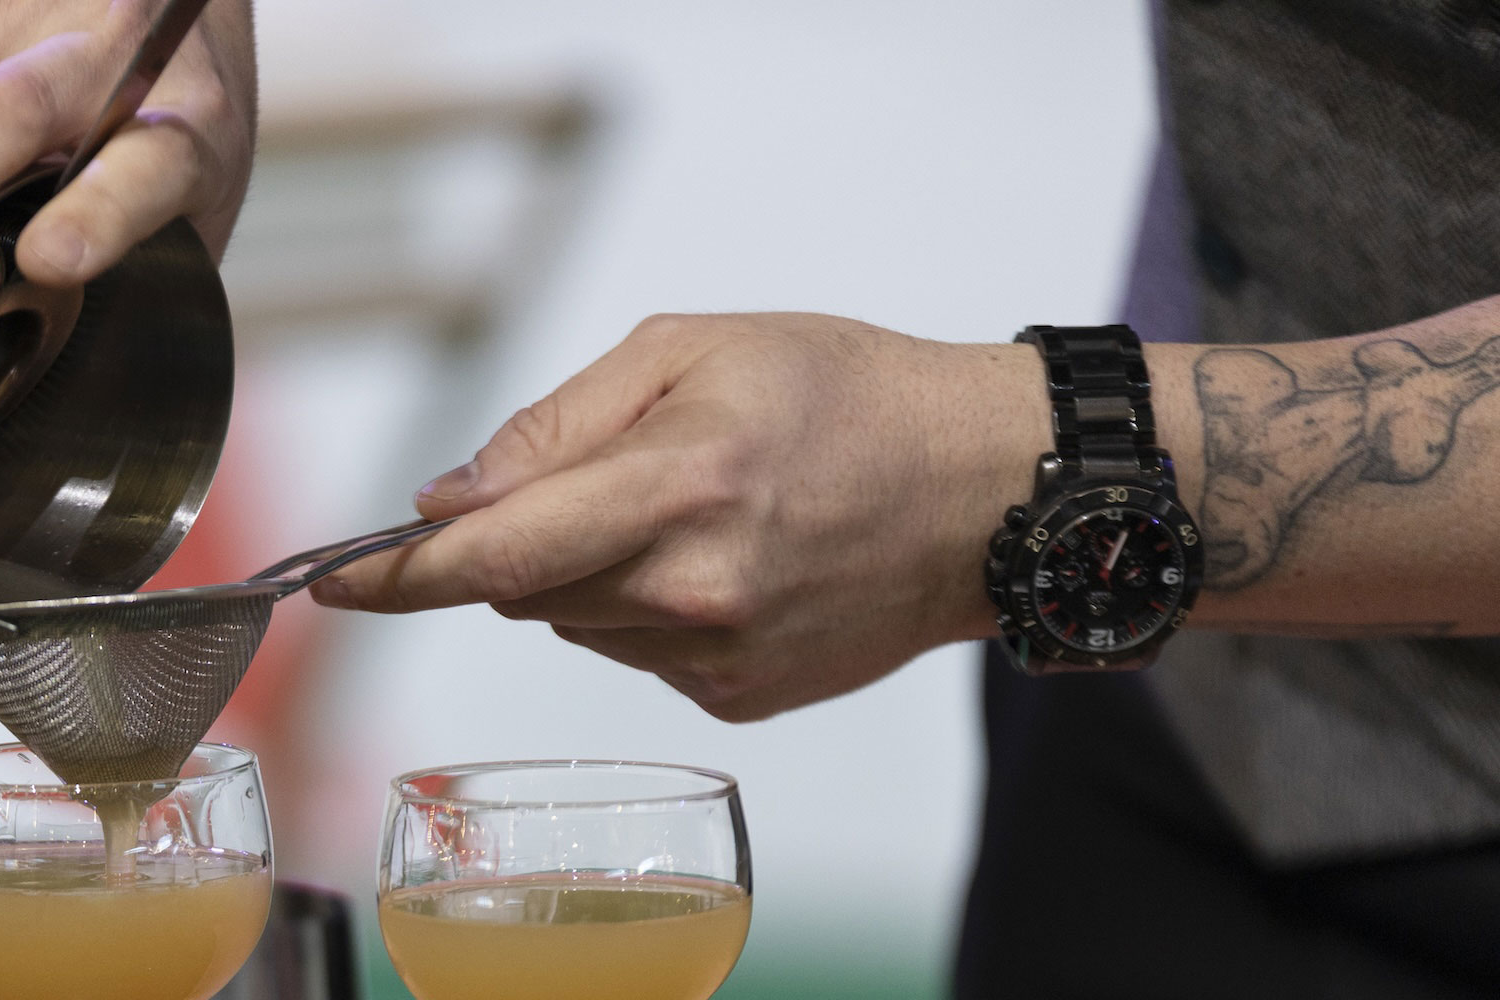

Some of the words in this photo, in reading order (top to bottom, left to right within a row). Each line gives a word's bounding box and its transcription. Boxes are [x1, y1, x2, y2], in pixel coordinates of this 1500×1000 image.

[1105, 487, 1129, 503] 30
[1025, 527, 1049, 553] 20
[1178, 524, 1198, 546] 40
[1088, 628, 1117, 647] 12
